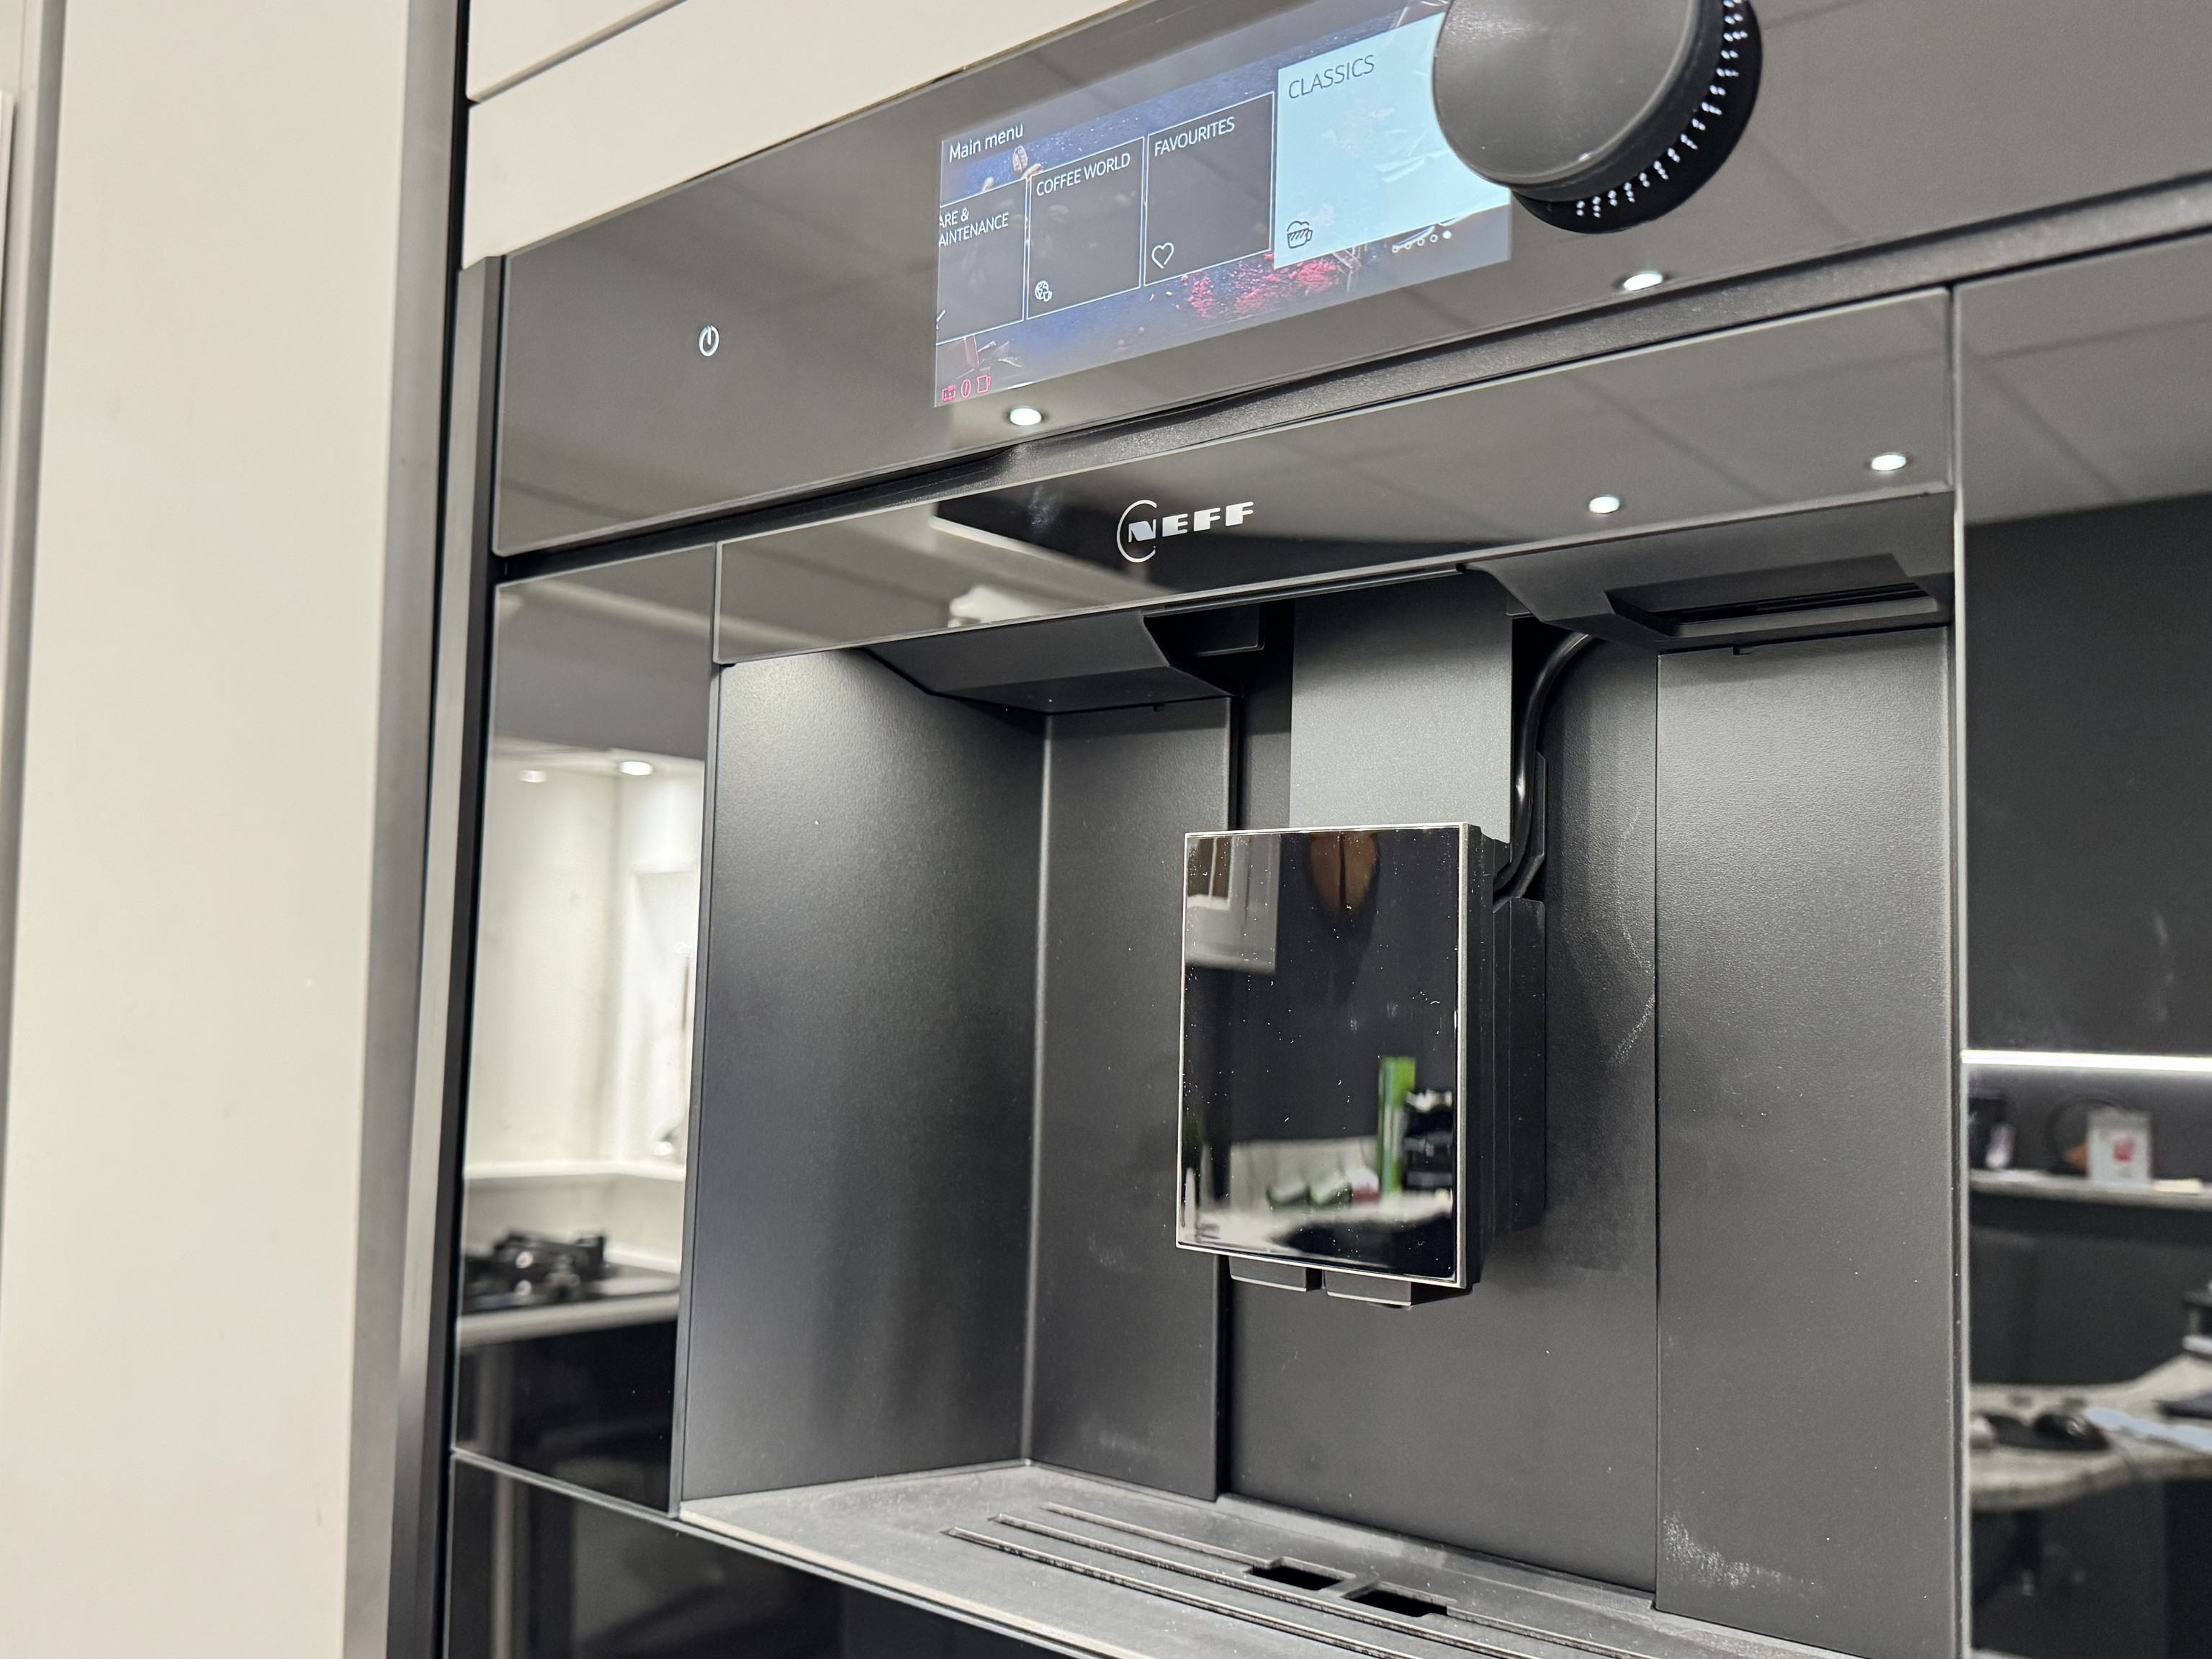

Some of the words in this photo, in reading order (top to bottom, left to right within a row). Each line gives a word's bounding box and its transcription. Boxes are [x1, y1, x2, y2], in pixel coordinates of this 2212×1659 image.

[1288, 54, 1375, 99] CLASSICS
[949, 138, 981, 163] Main
[985, 124, 1023, 150] menu
[1154, 116, 1235, 157] FAVOURITES
[1036, 168, 1082, 197] COFFEE
[1084, 153, 1130, 180] WORLD
[938, 212, 1009, 248] AINTENANCE
[961, 207, 969, 222] &
[1128, 501, 1254, 543] NEFF
